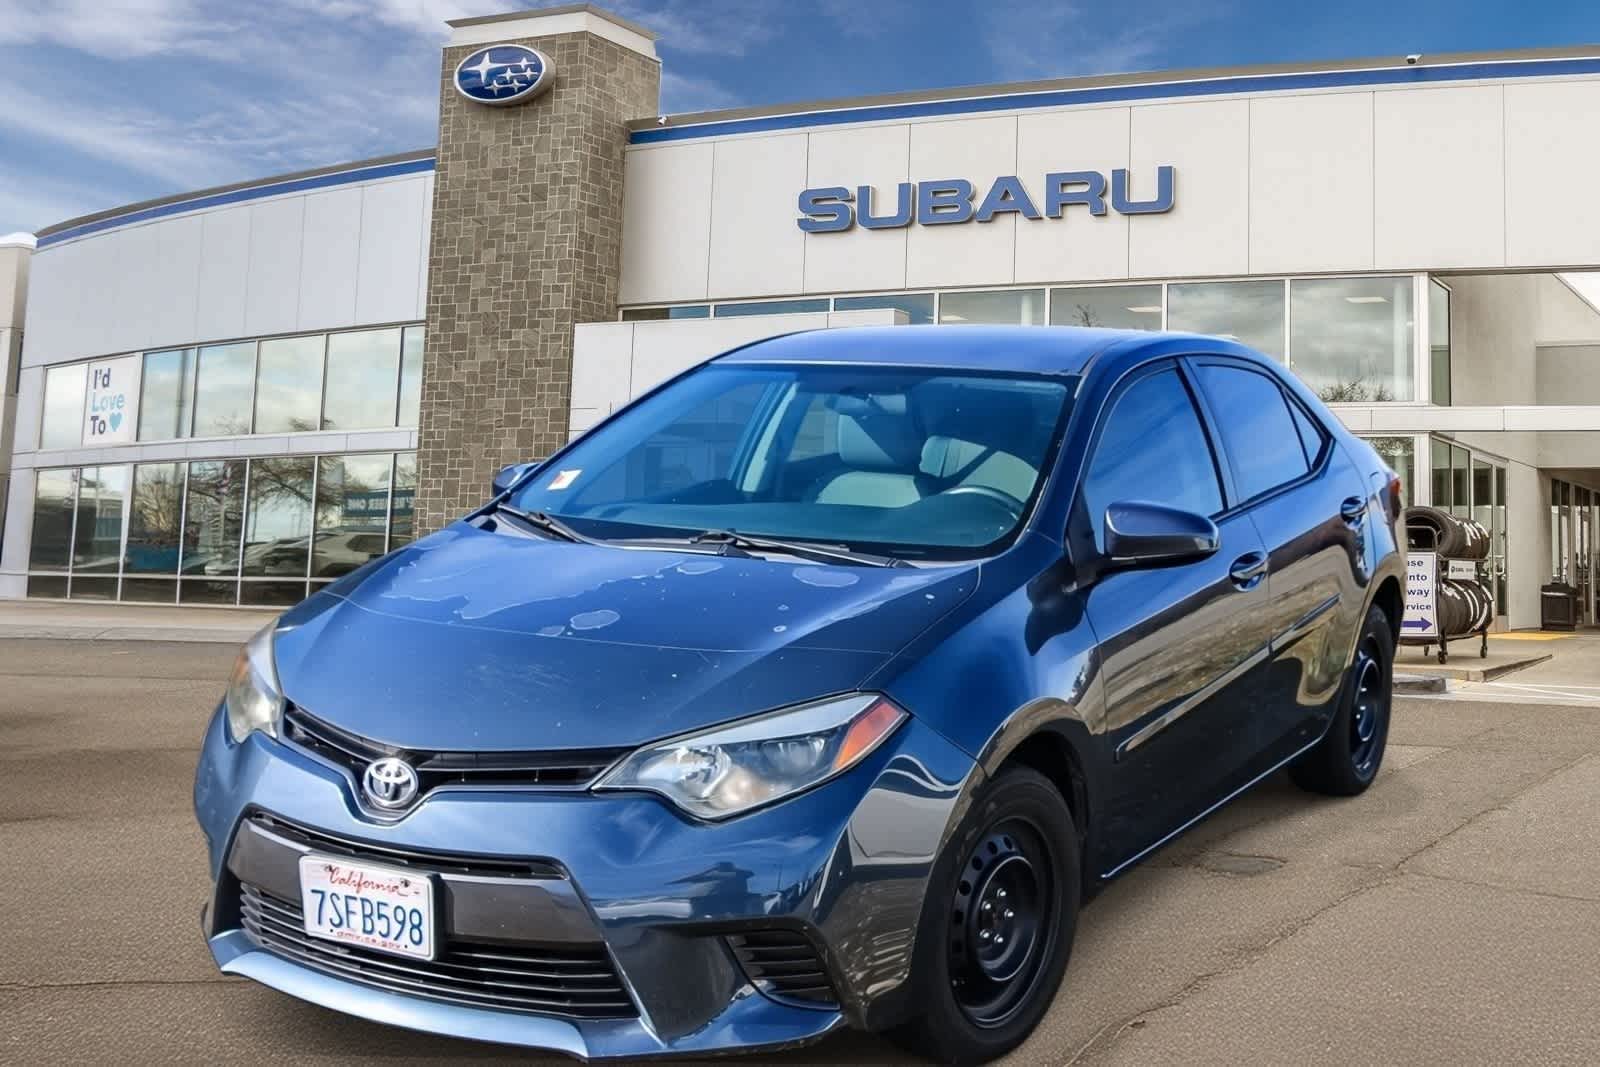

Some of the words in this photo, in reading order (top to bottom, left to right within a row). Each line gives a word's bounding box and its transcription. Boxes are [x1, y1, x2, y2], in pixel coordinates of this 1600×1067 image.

[797, 165, 1176, 233] SUBARU
[93, 367, 111, 389] I'd
[91, 391, 125, 412] Love
[90, 415, 106, 436] To
[1408, 572, 1427, 581] nto
[1406, 602, 1431, 611] rvice
[328, 865, 405, 894] California
[310, 888, 423, 946] 7SFB598
